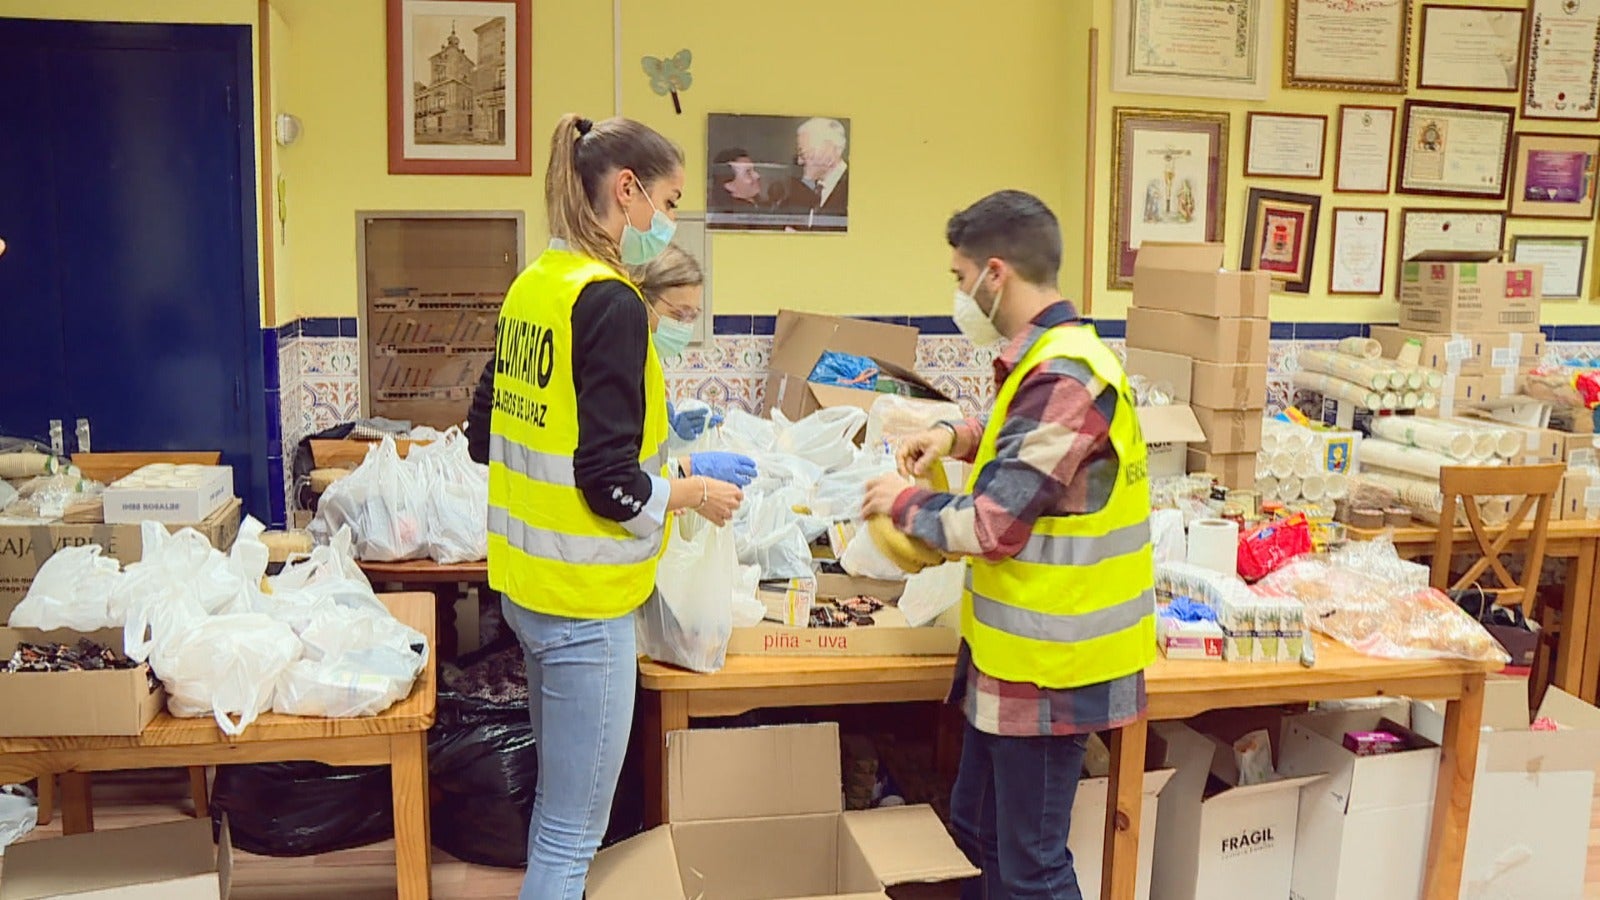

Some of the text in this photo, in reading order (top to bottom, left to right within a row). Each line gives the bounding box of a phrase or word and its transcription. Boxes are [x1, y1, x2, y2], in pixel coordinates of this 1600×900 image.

[764, 632, 799, 652] piña
[818, 635, 847, 649] uva
[1222, 828, 1274, 852] FRÁGIL
